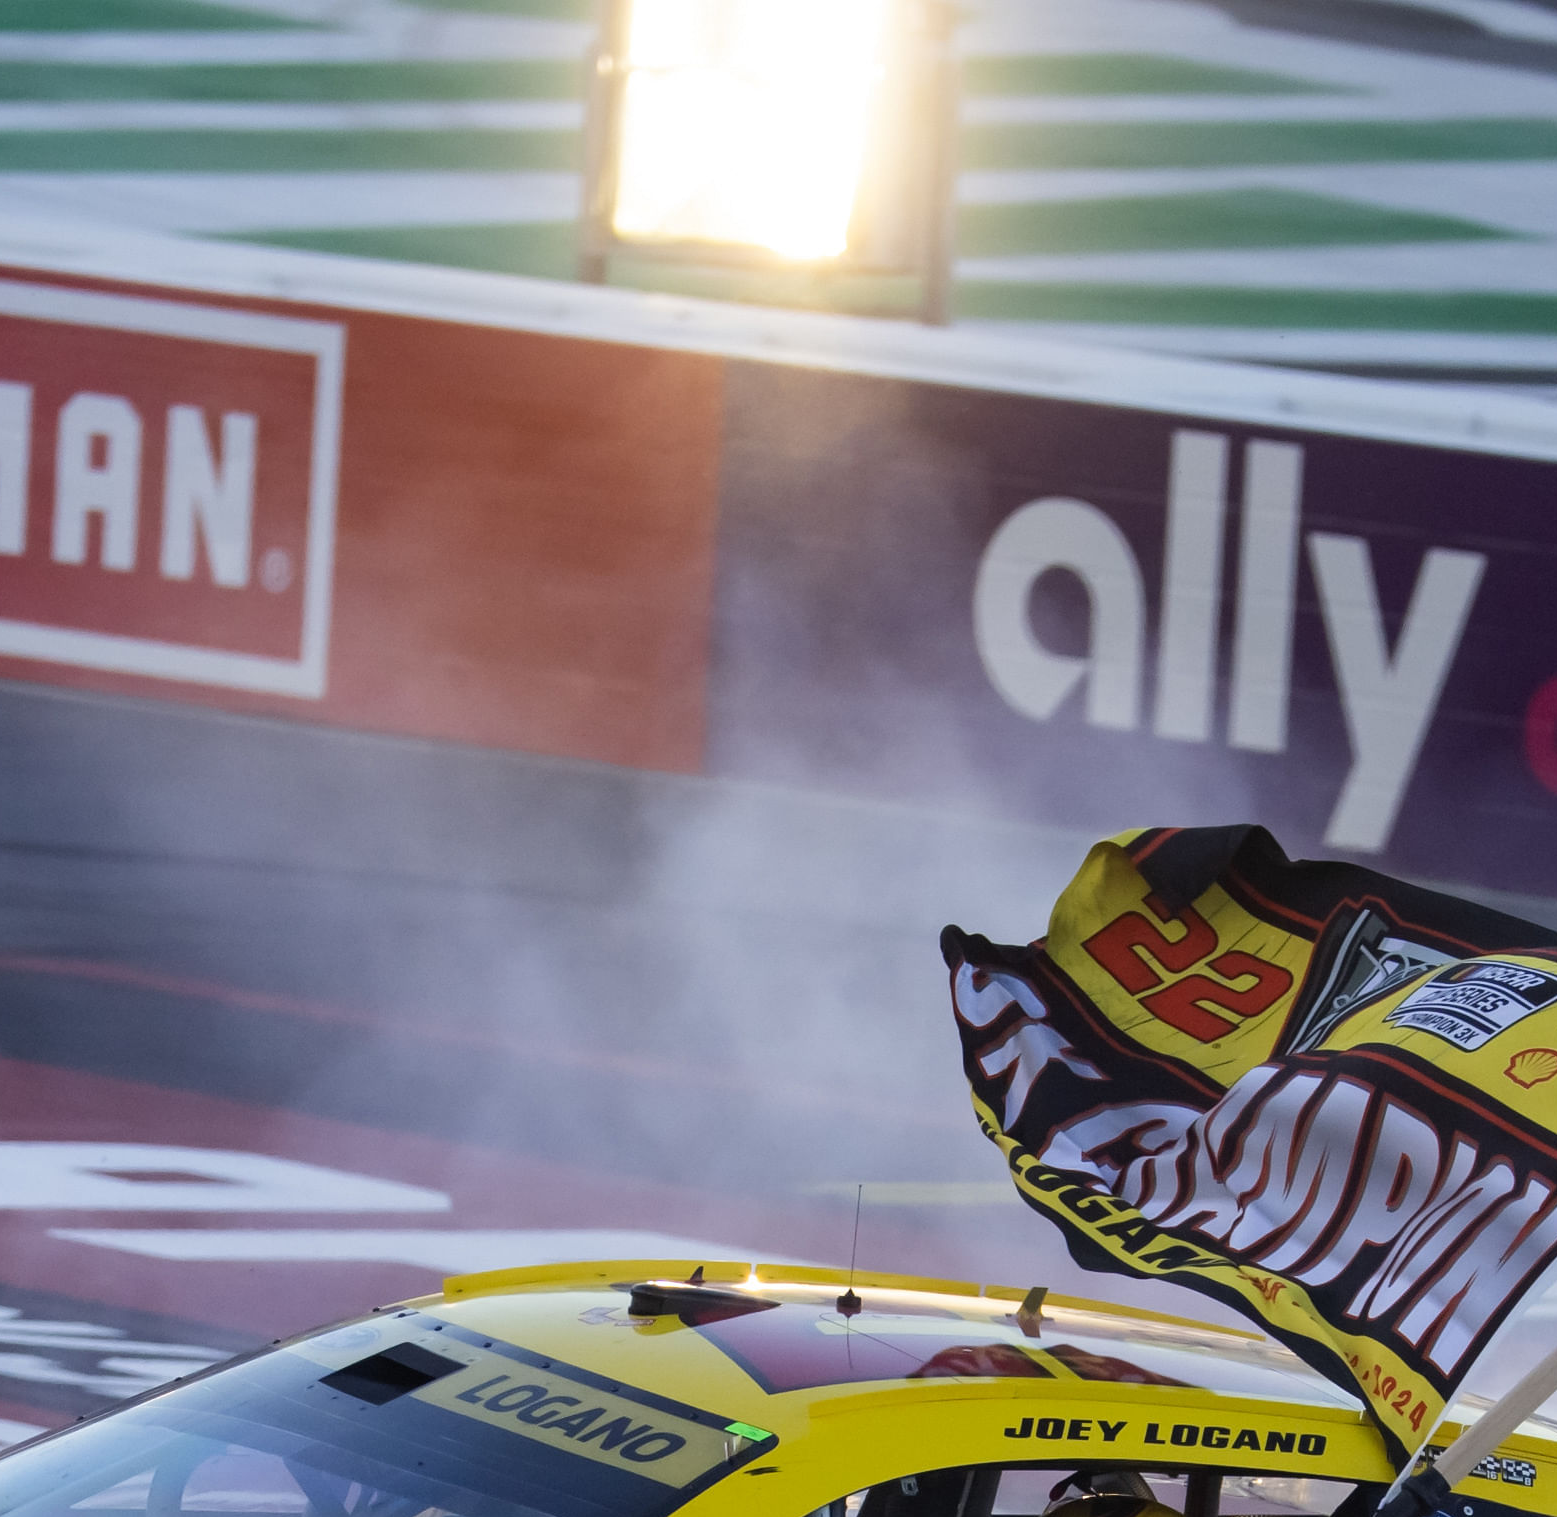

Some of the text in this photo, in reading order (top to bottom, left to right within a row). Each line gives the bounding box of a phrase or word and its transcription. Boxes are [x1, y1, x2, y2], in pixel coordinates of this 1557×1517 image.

[971, 430, 1487, 852] ally
[1081, 890, 1294, 1044] 22
[1455, 1025, 1477, 1045] 3X
[455, 1374, 686, 1463] LOGANO
[1004, 1418, 1328, 1456] JOEY LOGANO
